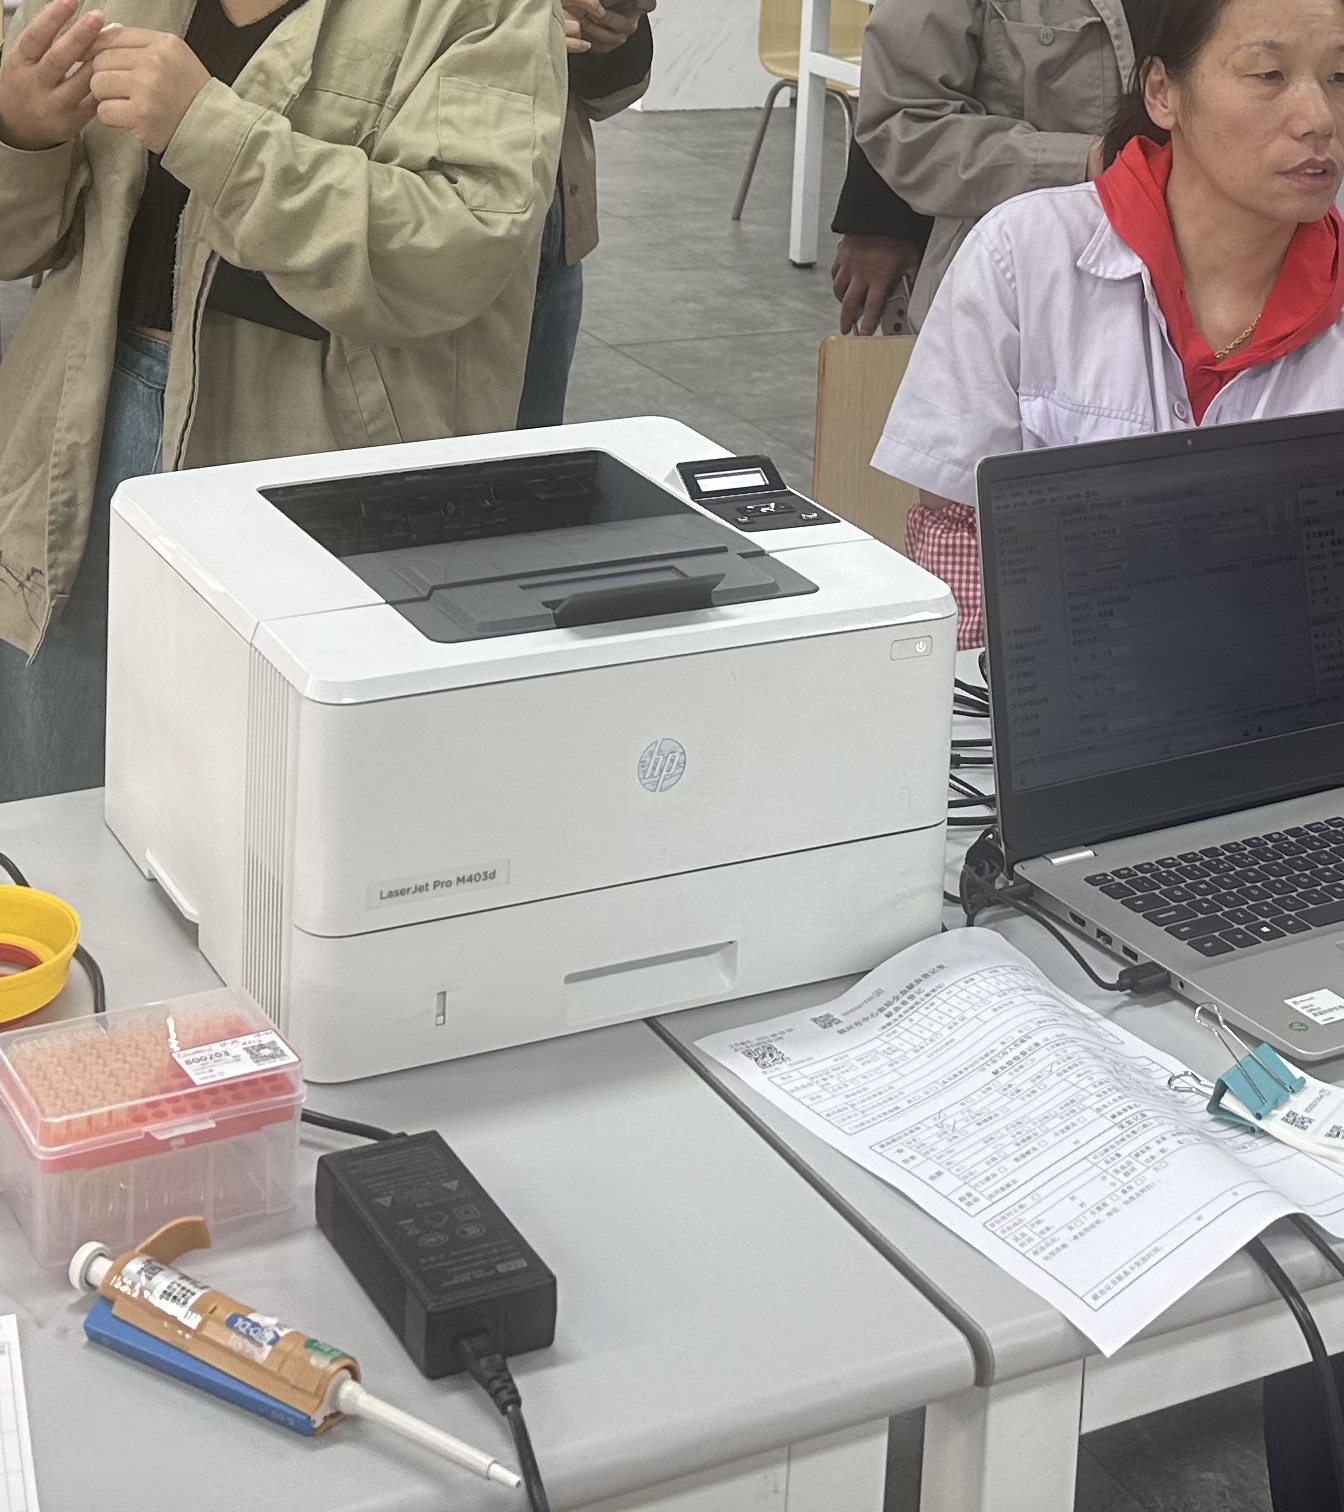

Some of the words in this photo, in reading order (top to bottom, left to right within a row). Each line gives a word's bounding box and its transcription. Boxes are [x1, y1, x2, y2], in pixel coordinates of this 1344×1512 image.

[641, 738, 683, 792] hp
[379, 881, 430, 901] LaserJet
[432, 878, 453, 891] Pro
[456, 869, 497, 887] M403d
[184, 1050, 230, 1066] 800203
